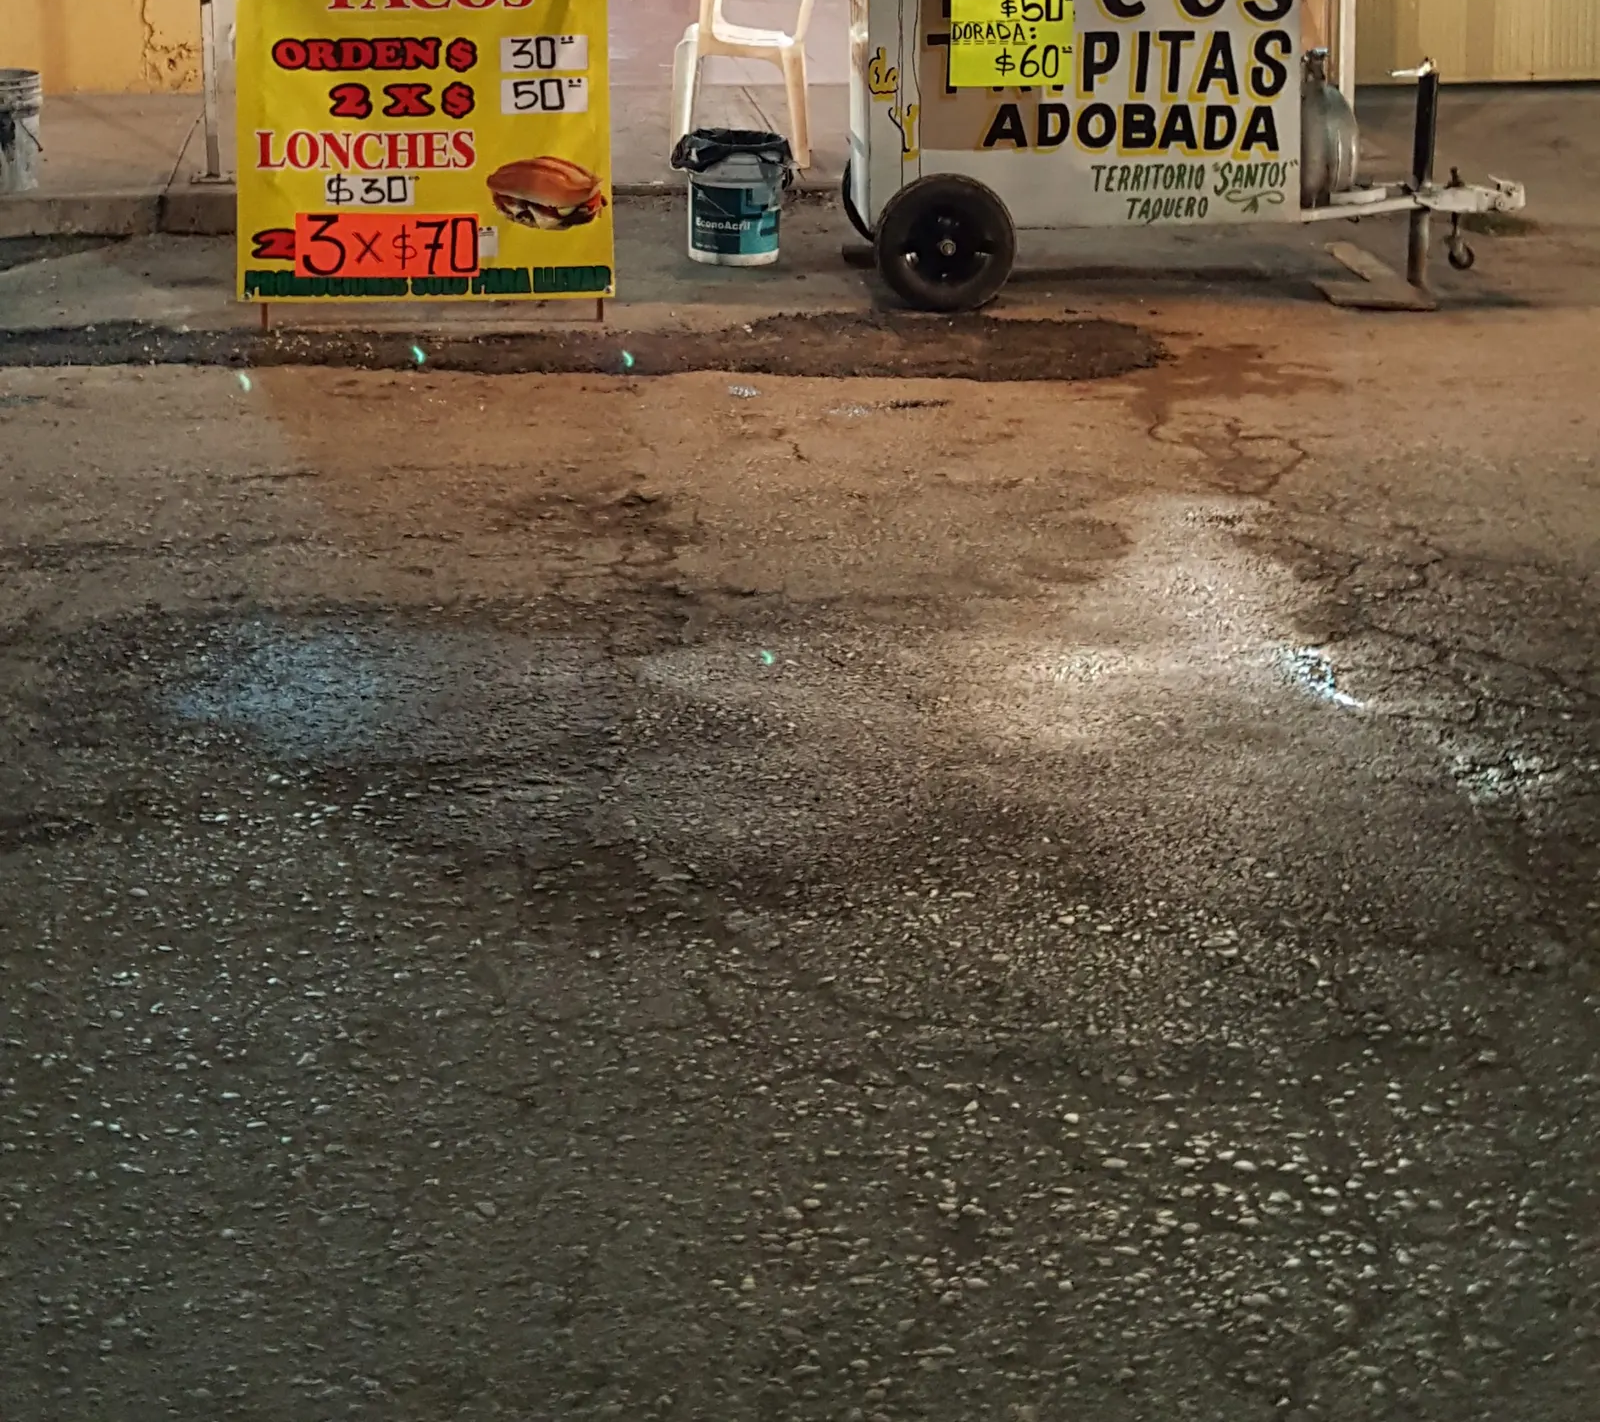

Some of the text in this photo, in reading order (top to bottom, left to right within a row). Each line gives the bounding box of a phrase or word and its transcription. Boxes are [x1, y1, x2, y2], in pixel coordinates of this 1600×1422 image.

[952, 23, 1036, 41] DORADA:
[272, 37, 442, 71] ORDEN
[446, 36, 478, 73] $
[329, 82, 373, 119] 2
[383, 82, 436, 118] X
[440, 81, 476, 119] $
[983, 103, 1279, 151] ADOBADA
[256, 130, 476, 170] LONCHES
[1091, 164, 1205, 192] TERRITORIO
[1126, 196, 1209, 224] TAQUERO
[302, 214, 346, 276] 3
